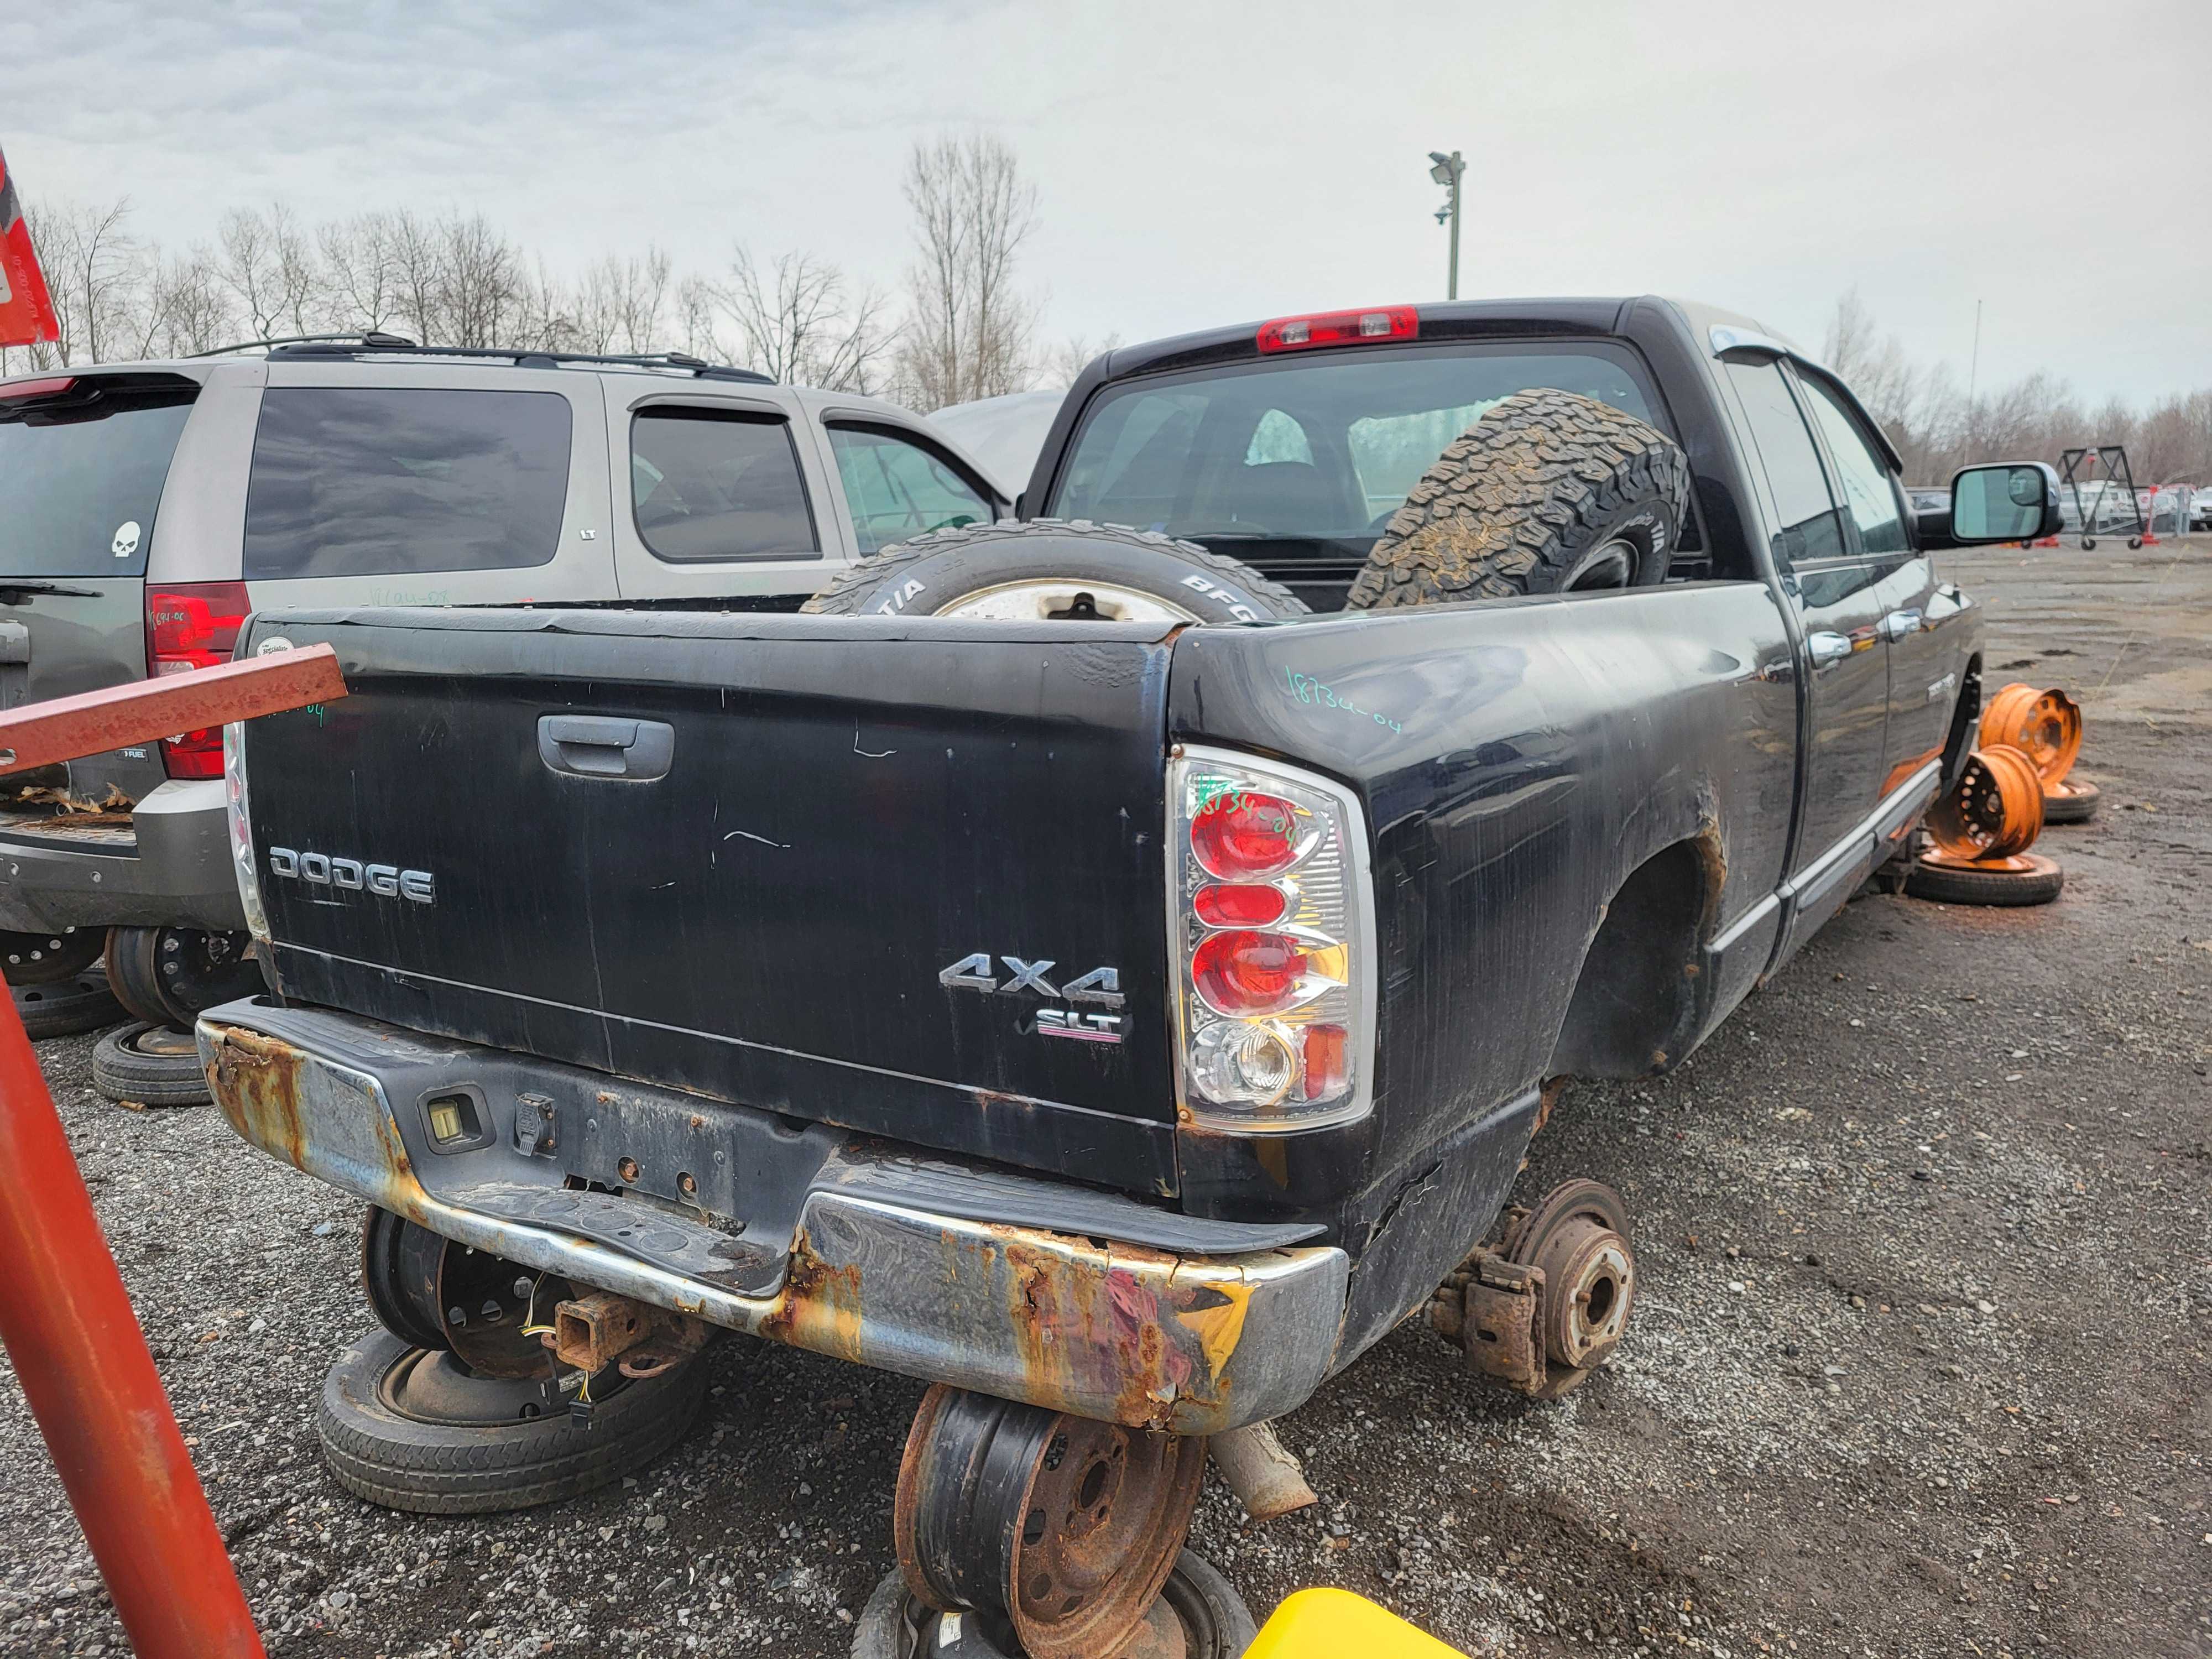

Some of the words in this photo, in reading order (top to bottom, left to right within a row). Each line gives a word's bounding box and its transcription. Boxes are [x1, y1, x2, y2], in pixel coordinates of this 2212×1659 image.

[581, 530, 596, 540] LT
[1285, 665, 1401, 735] 18734-04
[270, 846, 435, 904] DODGE
[939, 953, 1126, 1010] 4X4
[1036, 1009, 1121, 1034] SLT
